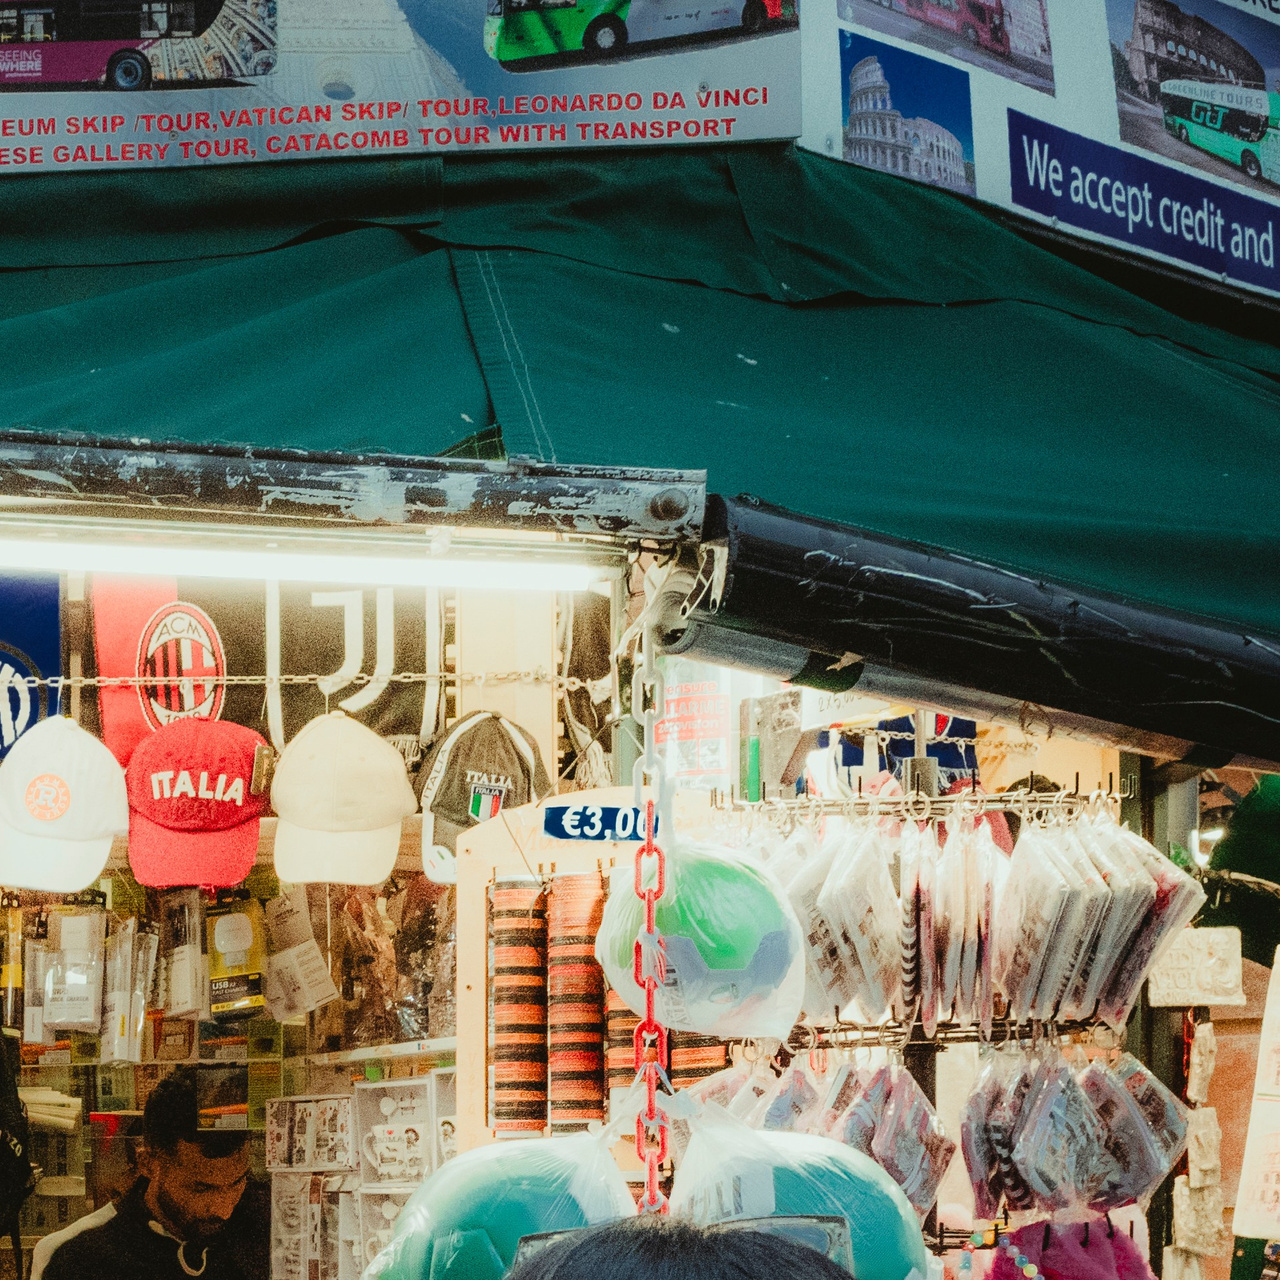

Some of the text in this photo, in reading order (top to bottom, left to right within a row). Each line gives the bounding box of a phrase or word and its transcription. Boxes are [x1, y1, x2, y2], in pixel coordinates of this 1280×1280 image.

[66, 114, 125, 135] SKIP
[652, 91, 686, 111] DA
[696, 87, 769, 109] VINCI
[53, 141, 169, 165] GALLERY
[179, 136, 257, 160] TOUR,
[266, 129, 409, 154] CATACOMB
[419, 124, 490, 147] TOUR
[500, 122, 568, 144] WITH
[580, 118, 736, 141] TRANSPORT
[1022, 134, 1275, 269] We accept credit and
[156, 616, 202, 643] ACM
[666, 700, 724, 718] LARME
[151, 770, 244, 806] ITALIA
[466, 770, 514, 791] ITALIA
